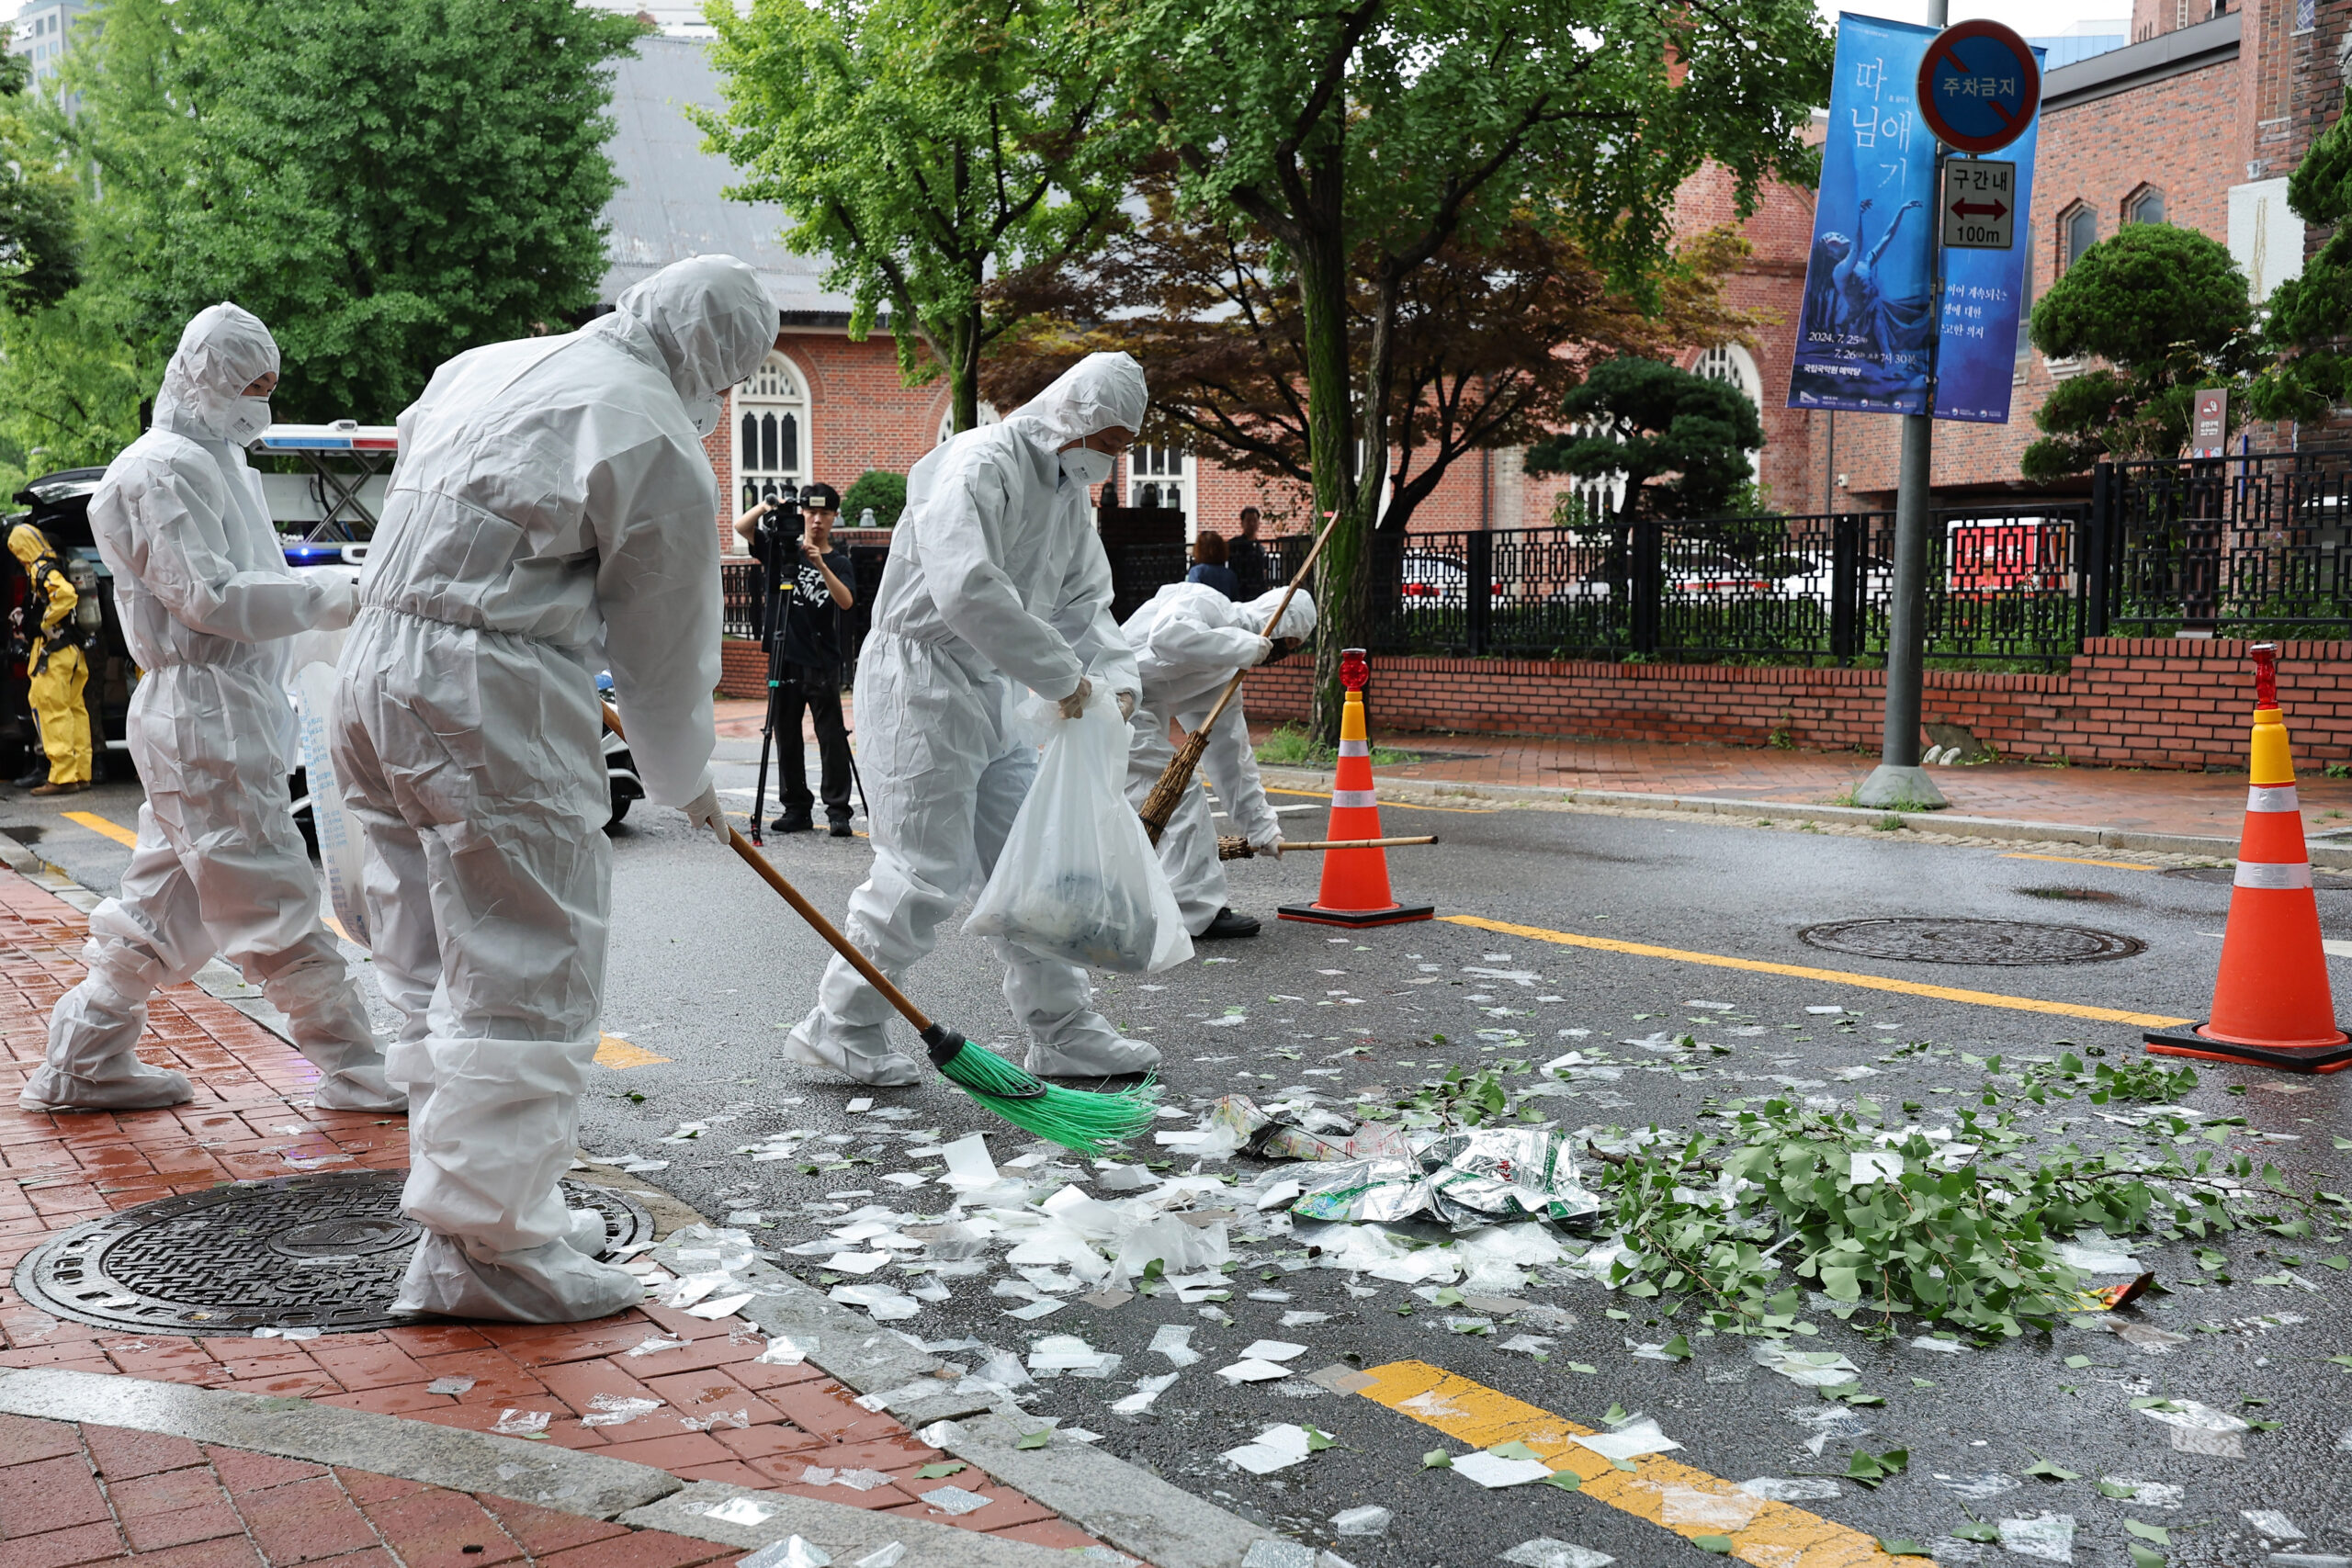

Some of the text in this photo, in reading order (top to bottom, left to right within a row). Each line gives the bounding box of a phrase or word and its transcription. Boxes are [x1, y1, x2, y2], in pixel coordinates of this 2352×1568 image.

[1856, 57, 1888, 102] 따
[1943, 76, 2015, 97] 주차금지
[1878, 157, 1907, 199] 기
[1957, 225, 2000, 243] 100m
[1964, 305, 1982, 319] 대한
[1808, 331, 1835, 344] 2024.
